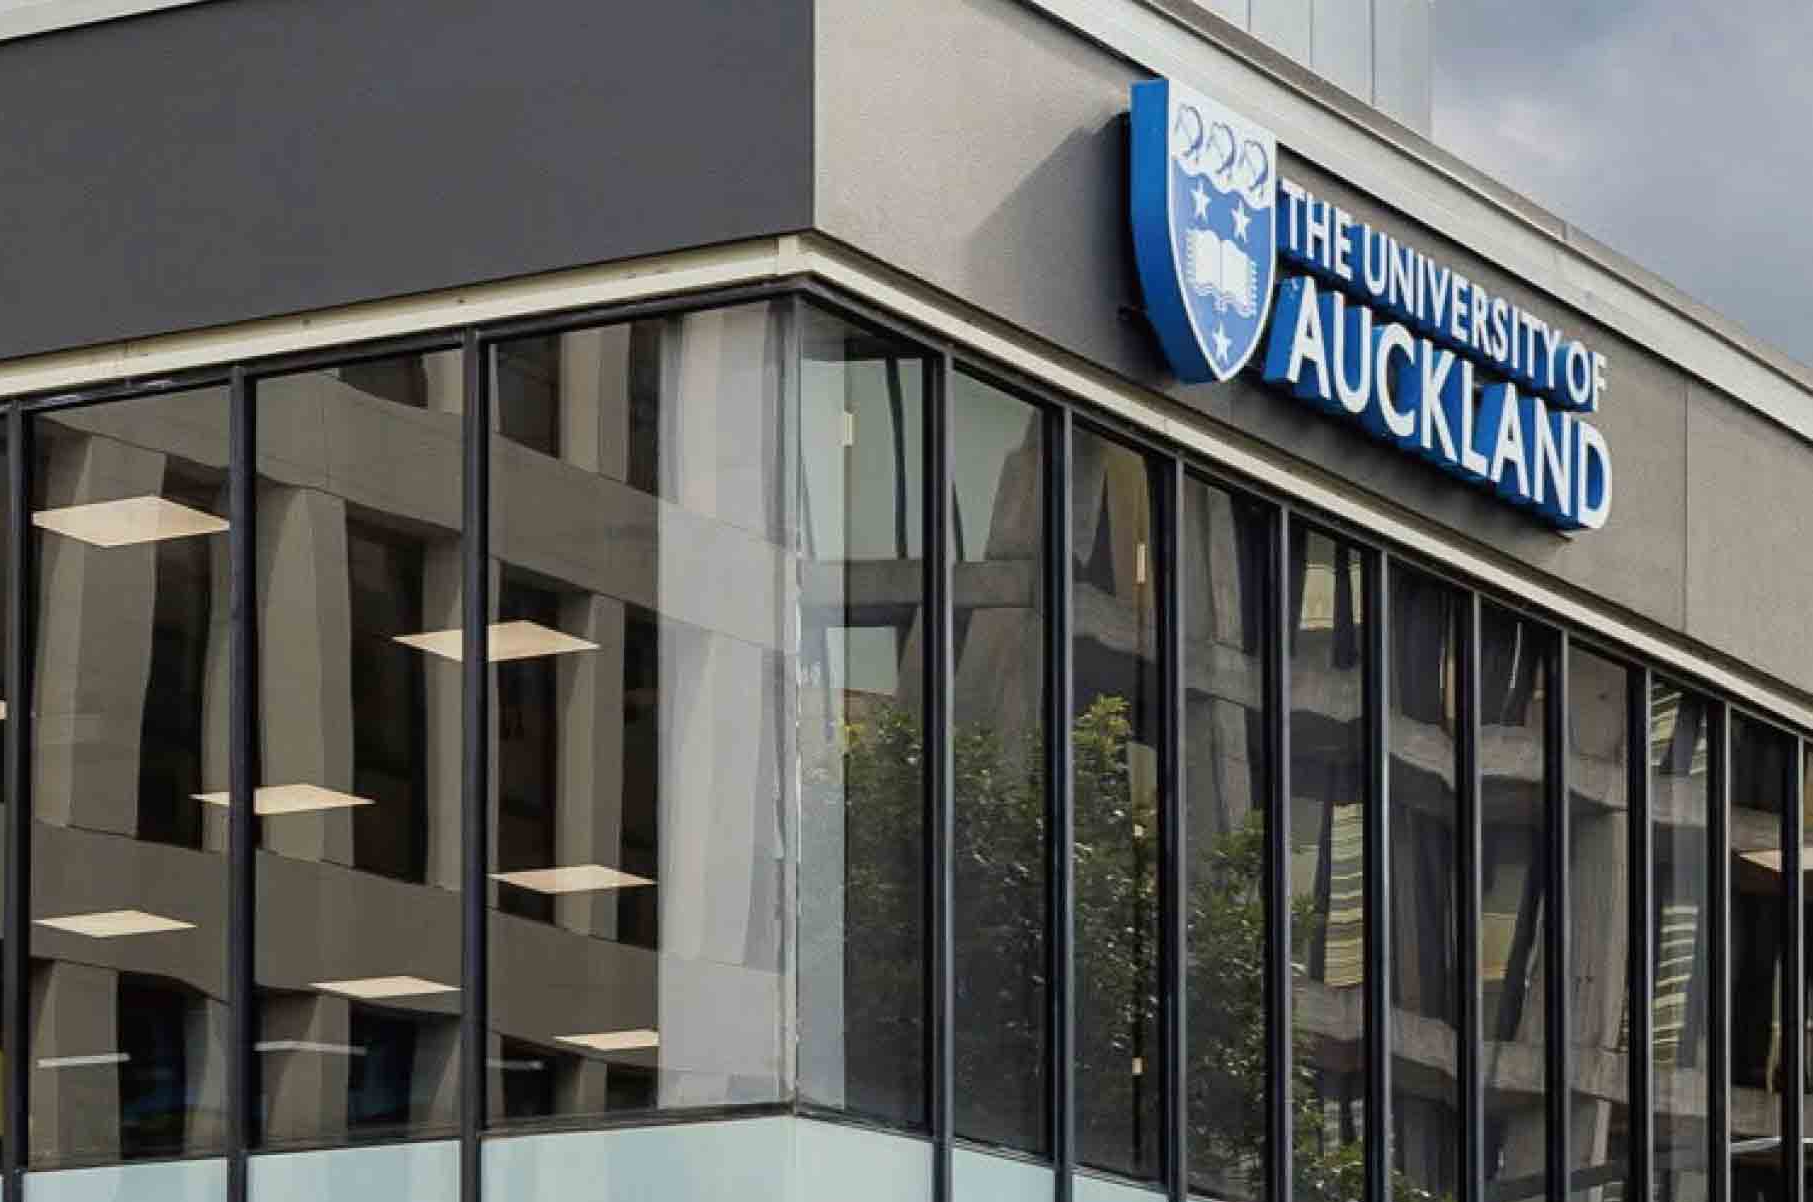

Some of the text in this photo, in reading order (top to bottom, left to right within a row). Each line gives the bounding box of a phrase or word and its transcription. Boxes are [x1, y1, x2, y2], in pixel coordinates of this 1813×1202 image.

[1280, 176, 1606, 412] THE UNIVERSITY OF
[1284, 275, 1613, 530] AUCKLAND
